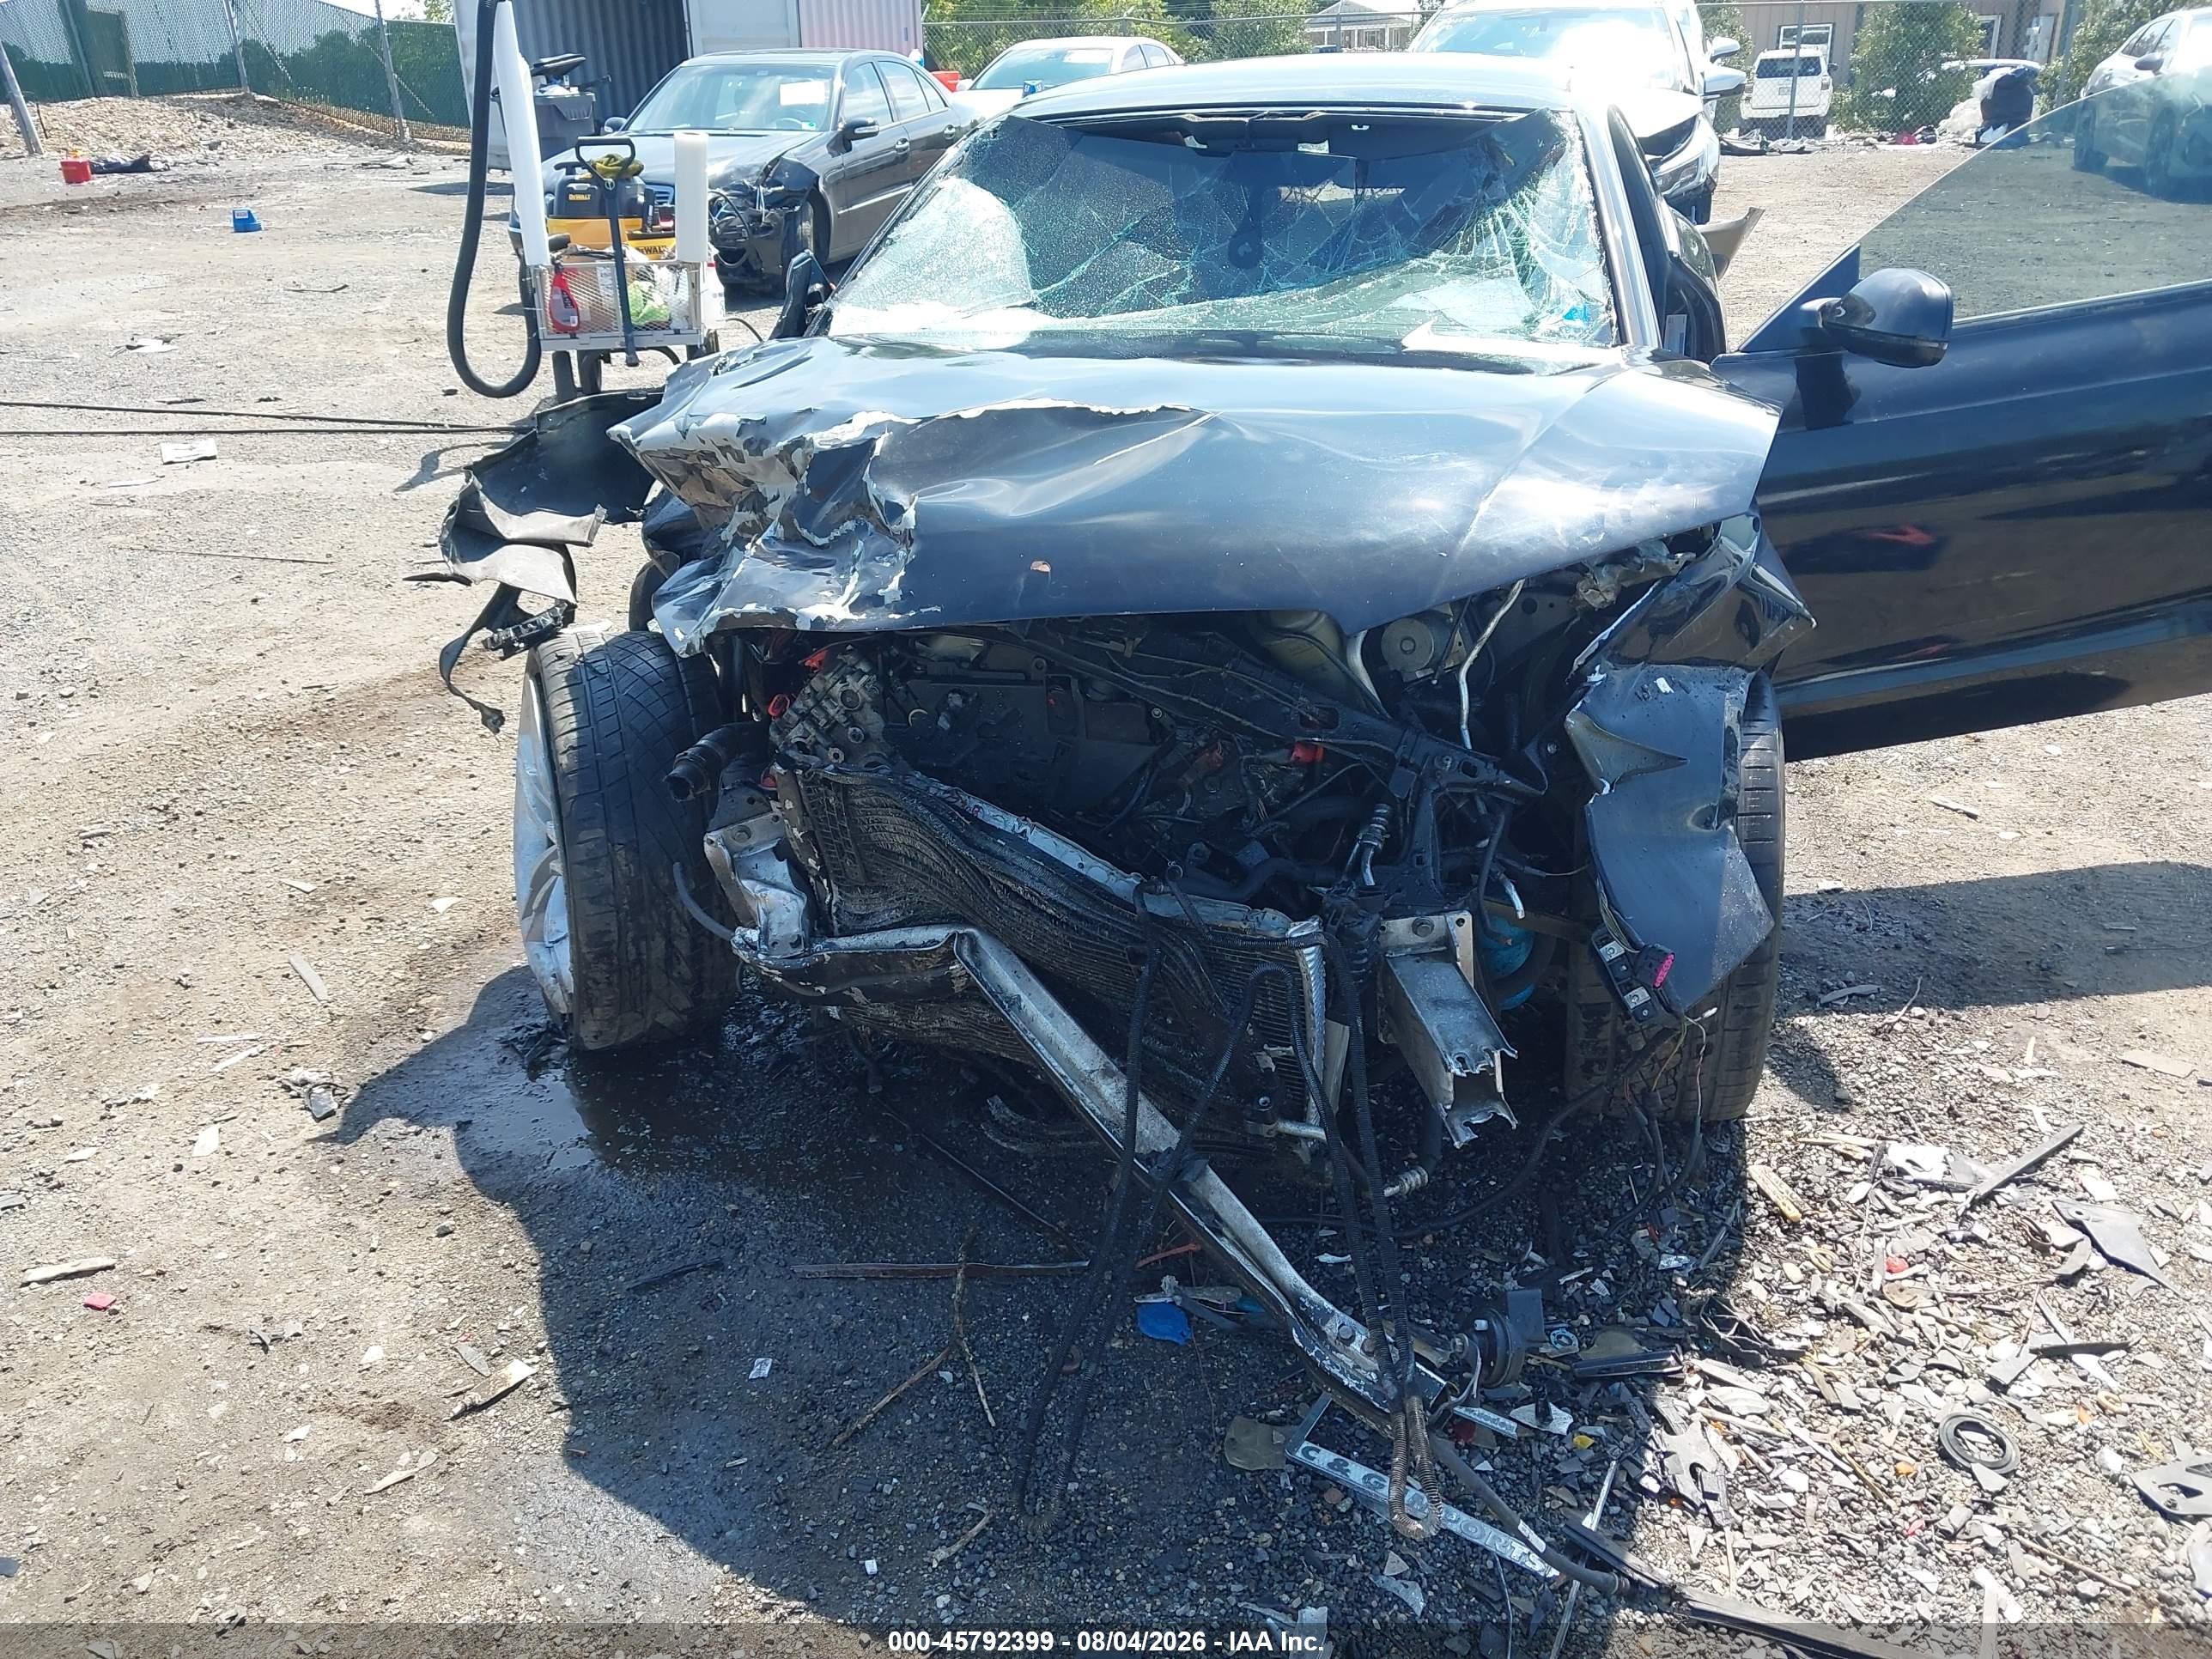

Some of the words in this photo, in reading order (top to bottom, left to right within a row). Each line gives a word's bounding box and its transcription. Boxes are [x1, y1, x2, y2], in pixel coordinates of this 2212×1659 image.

[1301, 1445, 1322, 1462] C
[1327, 1458, 1351, 1478] &
[1362, 1473, 1387, 1490] G
